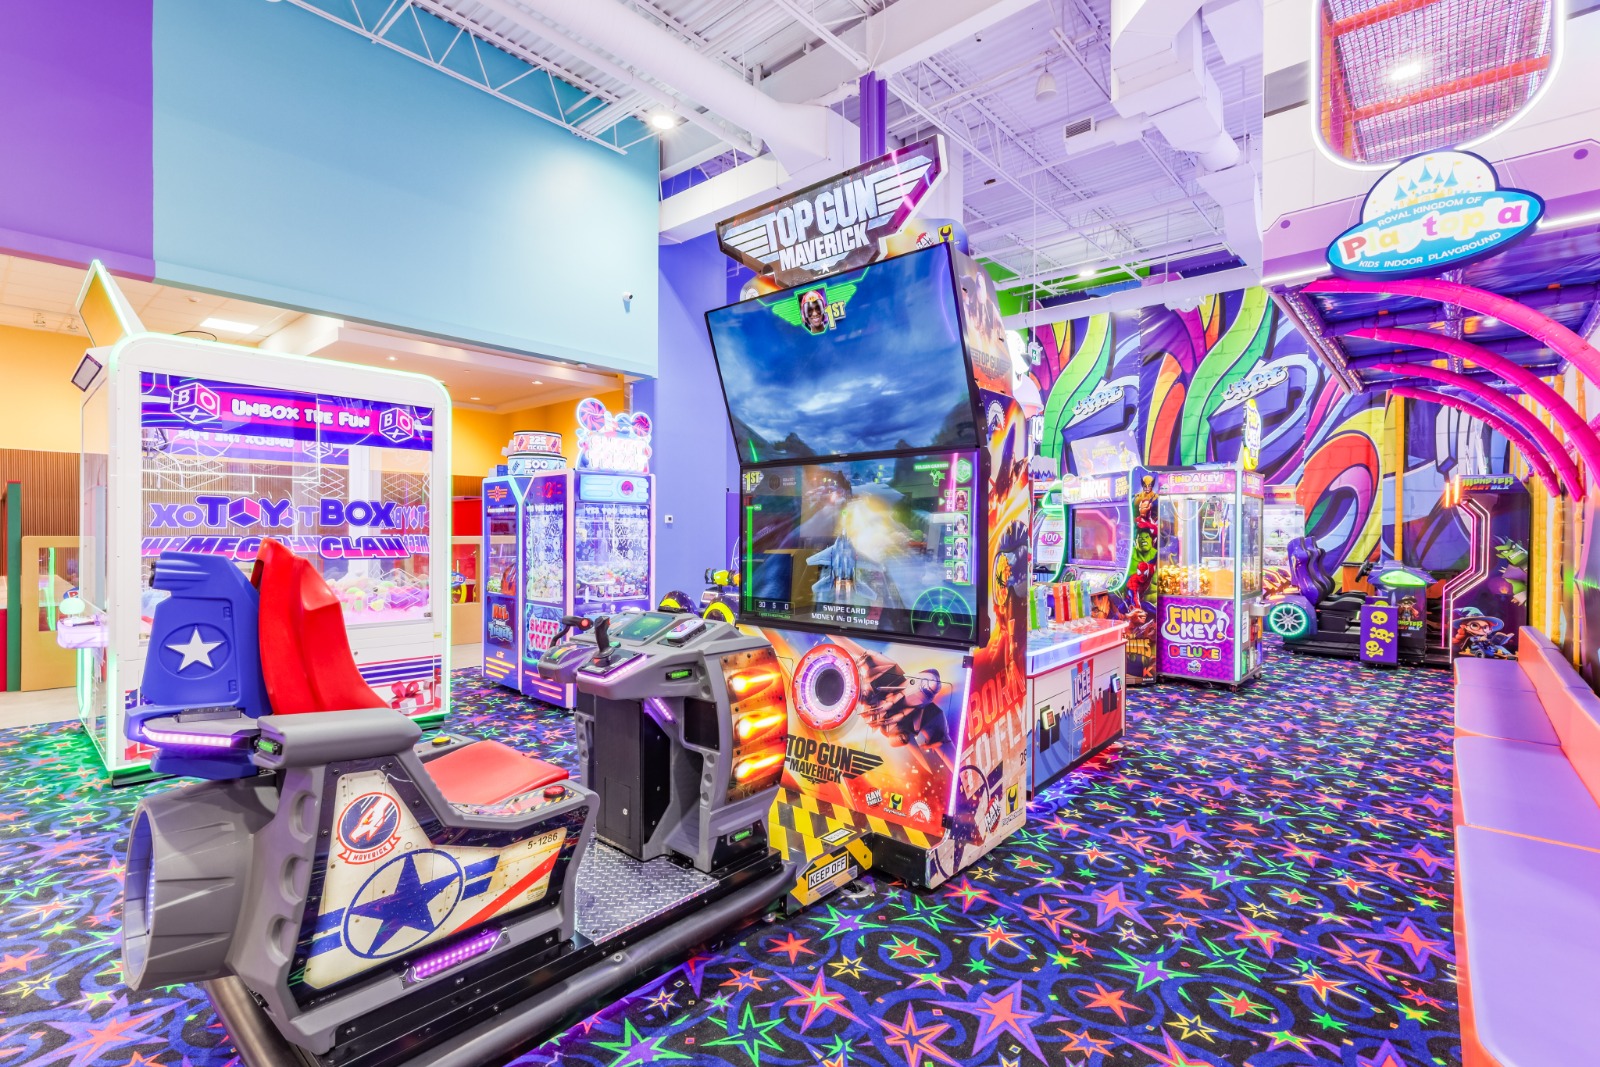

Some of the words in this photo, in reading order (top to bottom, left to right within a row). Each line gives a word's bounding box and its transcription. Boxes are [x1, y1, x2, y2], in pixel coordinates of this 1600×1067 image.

[765, 199, 814, 253] TOP
[814, 175, 877, 233] GUN
[1377, 211, 1411, 227] ROYAL
[1413, 198, 1464, 215] KINGDOM
[1466, 196, 1482, 205] OF
[1342, 204, 1523, 260] Platopa
[779, 222, 870, 272] MAVERICK
[1359, 260, 1380, 268] KIDS
[1384, 256, 1423, 268] INDOOR
[1428, 232, 1502, 261] PLAYGROUND
[825, 300, 847, 331] 1ST
[231, 398, 300, 420] UNBOX
[304, 408, 334, 425] THE
[338, 411, 371, 428] FUN
[529, 435, 547, 445] 225
[525, 459, 548, 469] 500
[745, 471, 761, 493] 1ST
[1169, 473, 1191, 483] FIND
[1202, 472, 1224, 483] KEY!
[1463, 476, 1514, 486] MONSTER
[195, 494, 291, 528] TOY
[320, 498, 397, 528] BOX
[178, 536, 263, 562] MEG
[319, 535, 411, 559] CLAW
[1044, 533, 1059, 543] 100
[811, 612, 834, 621] MONEY
[823, 605, 845, 613] SWIPE
[846, 607, 866, 615] CARD
[1168, 605, 1215, 624] FIND
[529, 618, 560, 635] SWEET
[1180, 618, 1224, 640] KEY!
[1169, 645, 1220, 660] DELUXE
[1074, 667, 1091, 706] ICEE
[967, 667, 1027, 740] BORN
[993, 697, 1027, 762] FLY
[786, 734, 817, 760] TOP
[817, 742, 853, 773] GUN
[789, 759, 842, 784] MAVERICK
[866, 790, 882, 801] RAW
[527, 832, 558, 850] 5-1286
[352, 845, 388, 861] MAVERICK
[810, 866, 830, 885] KEEP
[831, 858, 845, 873] OFF
